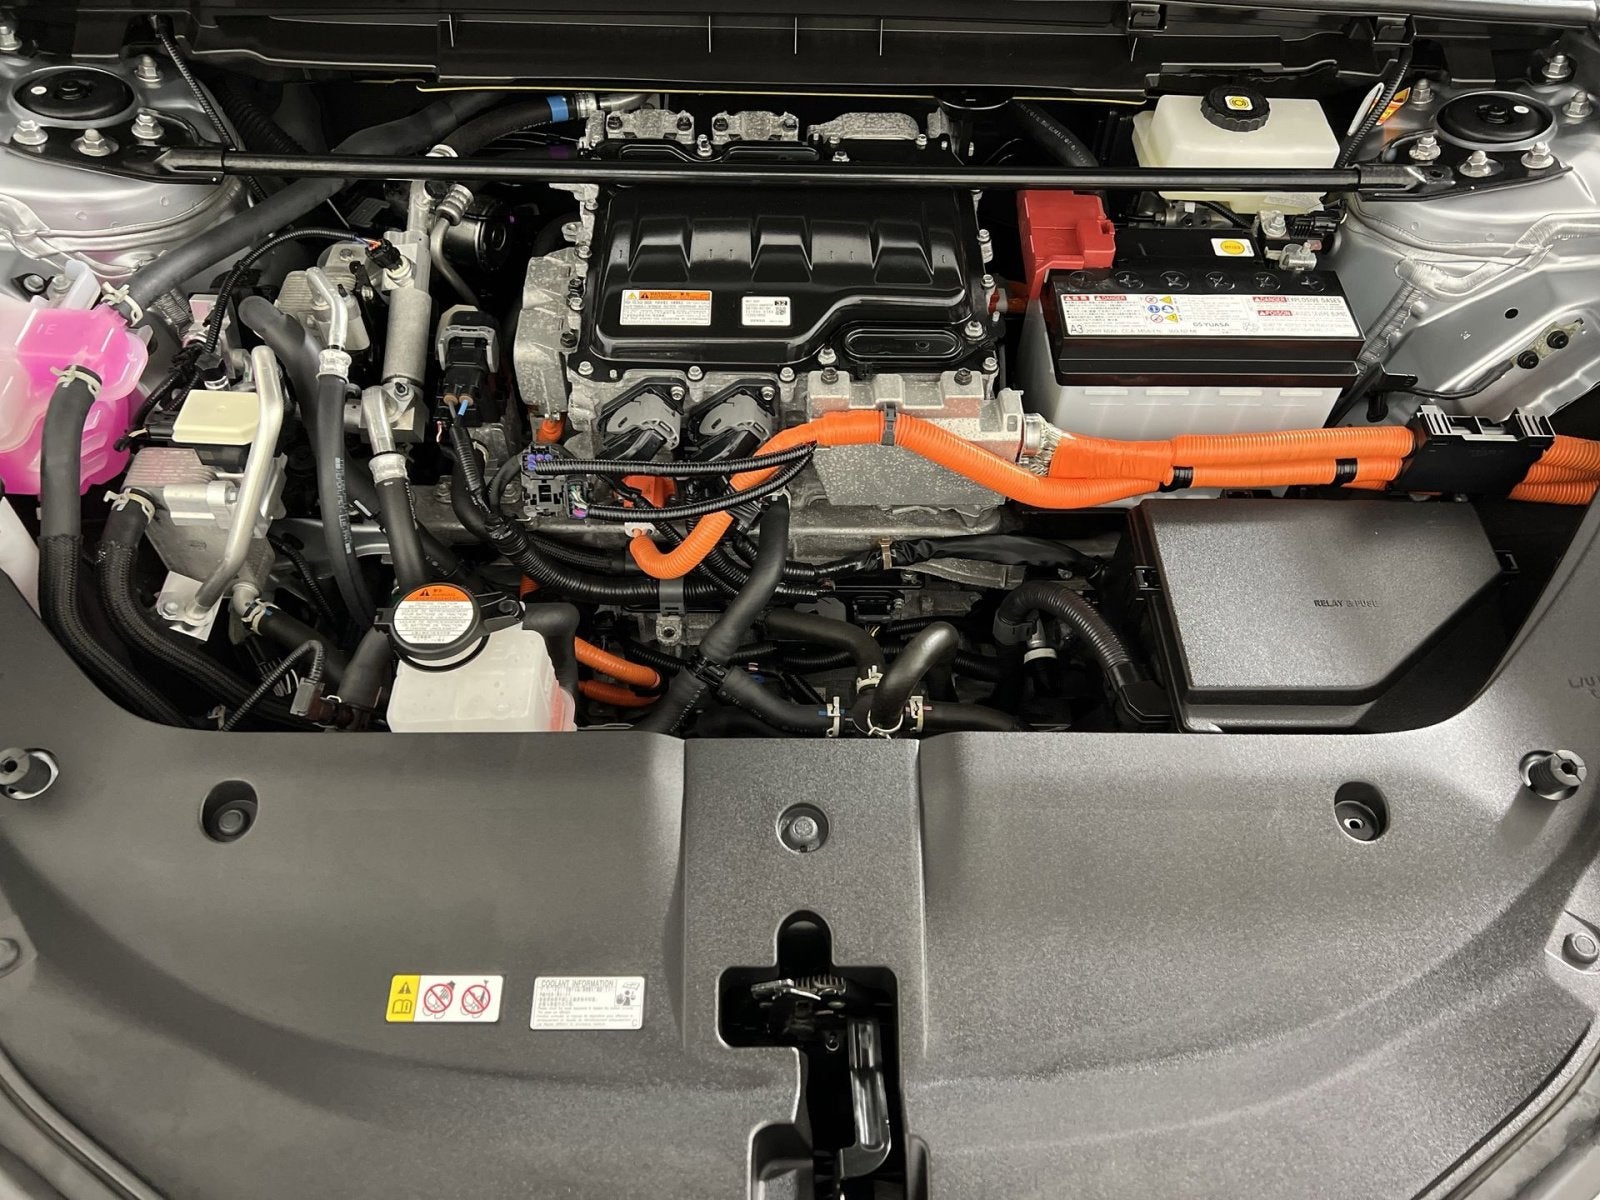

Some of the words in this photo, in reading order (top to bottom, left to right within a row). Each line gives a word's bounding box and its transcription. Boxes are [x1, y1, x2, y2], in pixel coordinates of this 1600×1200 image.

[1070, 324, 1084, 334] A3
[1313, 599, 1343, 607] RELAY
[1354, 599, 1379, 607] FUSE
[541, 979, 570, 987] COOLANT
[572, 979, 614, 987] INFORMATION
